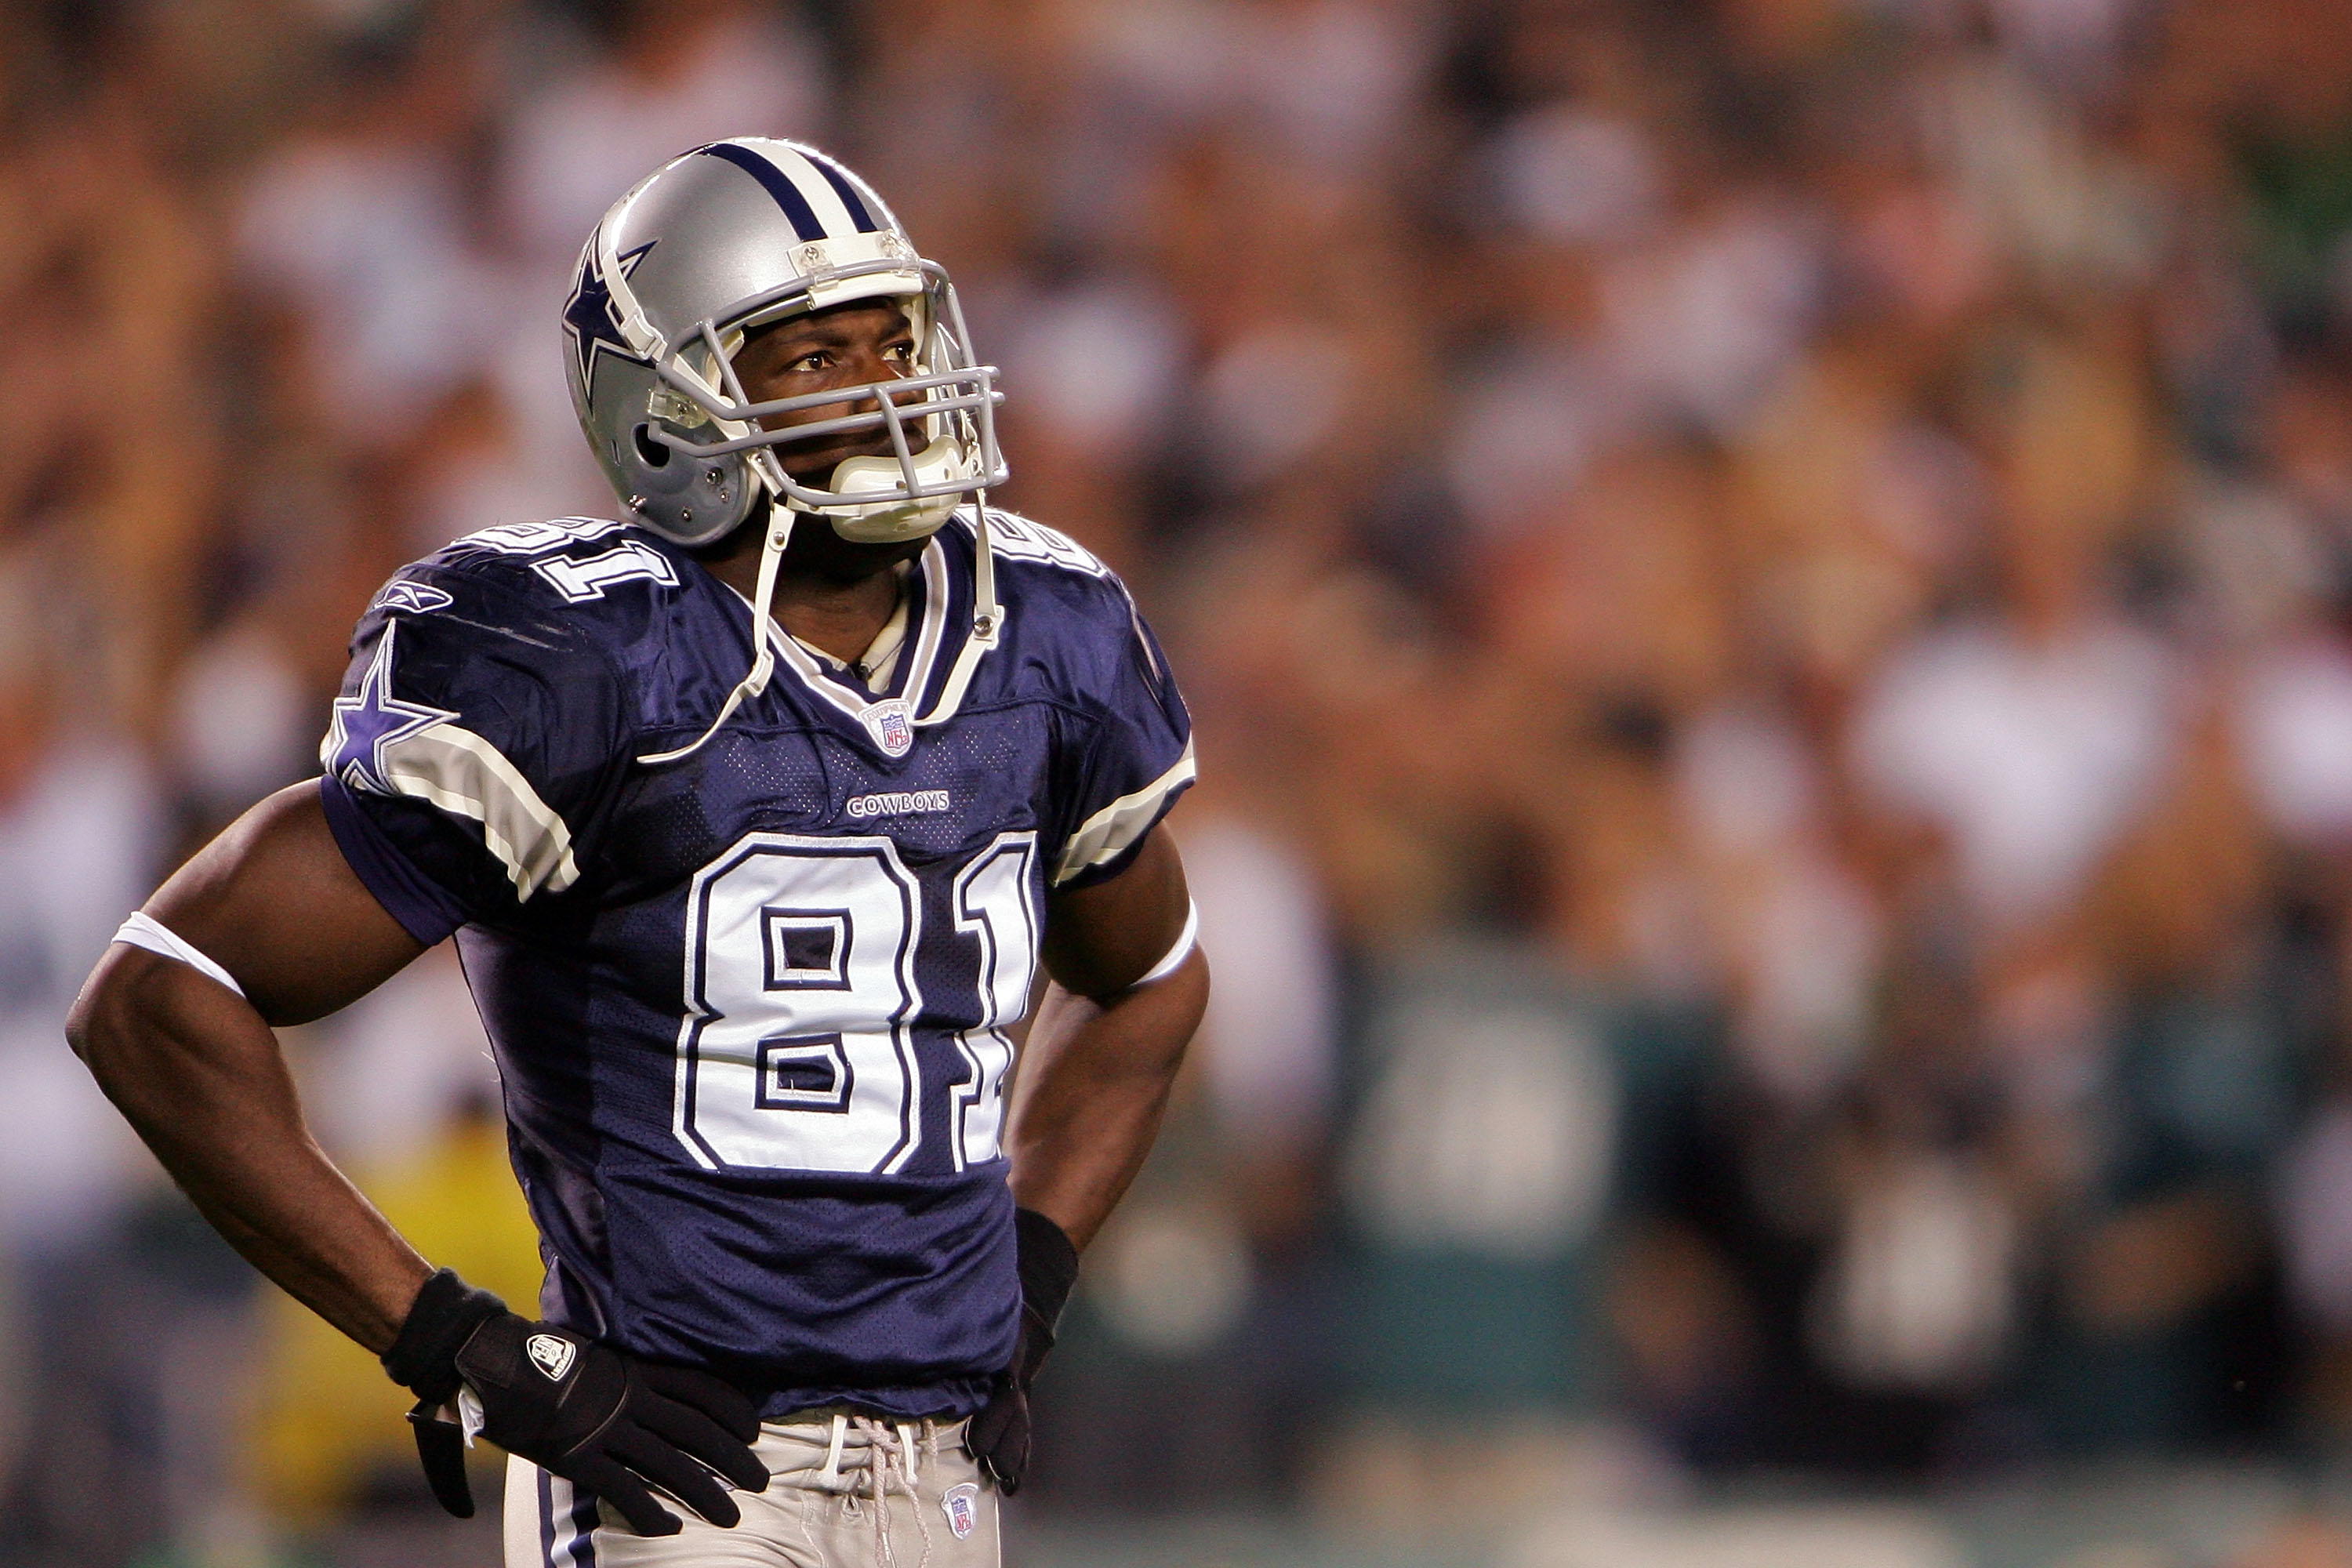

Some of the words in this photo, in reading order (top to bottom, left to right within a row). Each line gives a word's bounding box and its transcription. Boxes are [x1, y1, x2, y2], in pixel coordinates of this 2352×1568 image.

[886, 728, 909, 747] NFL
[847, 790, 949, 817] COWBOYS
[672, 831, 1037, 1174] 81
